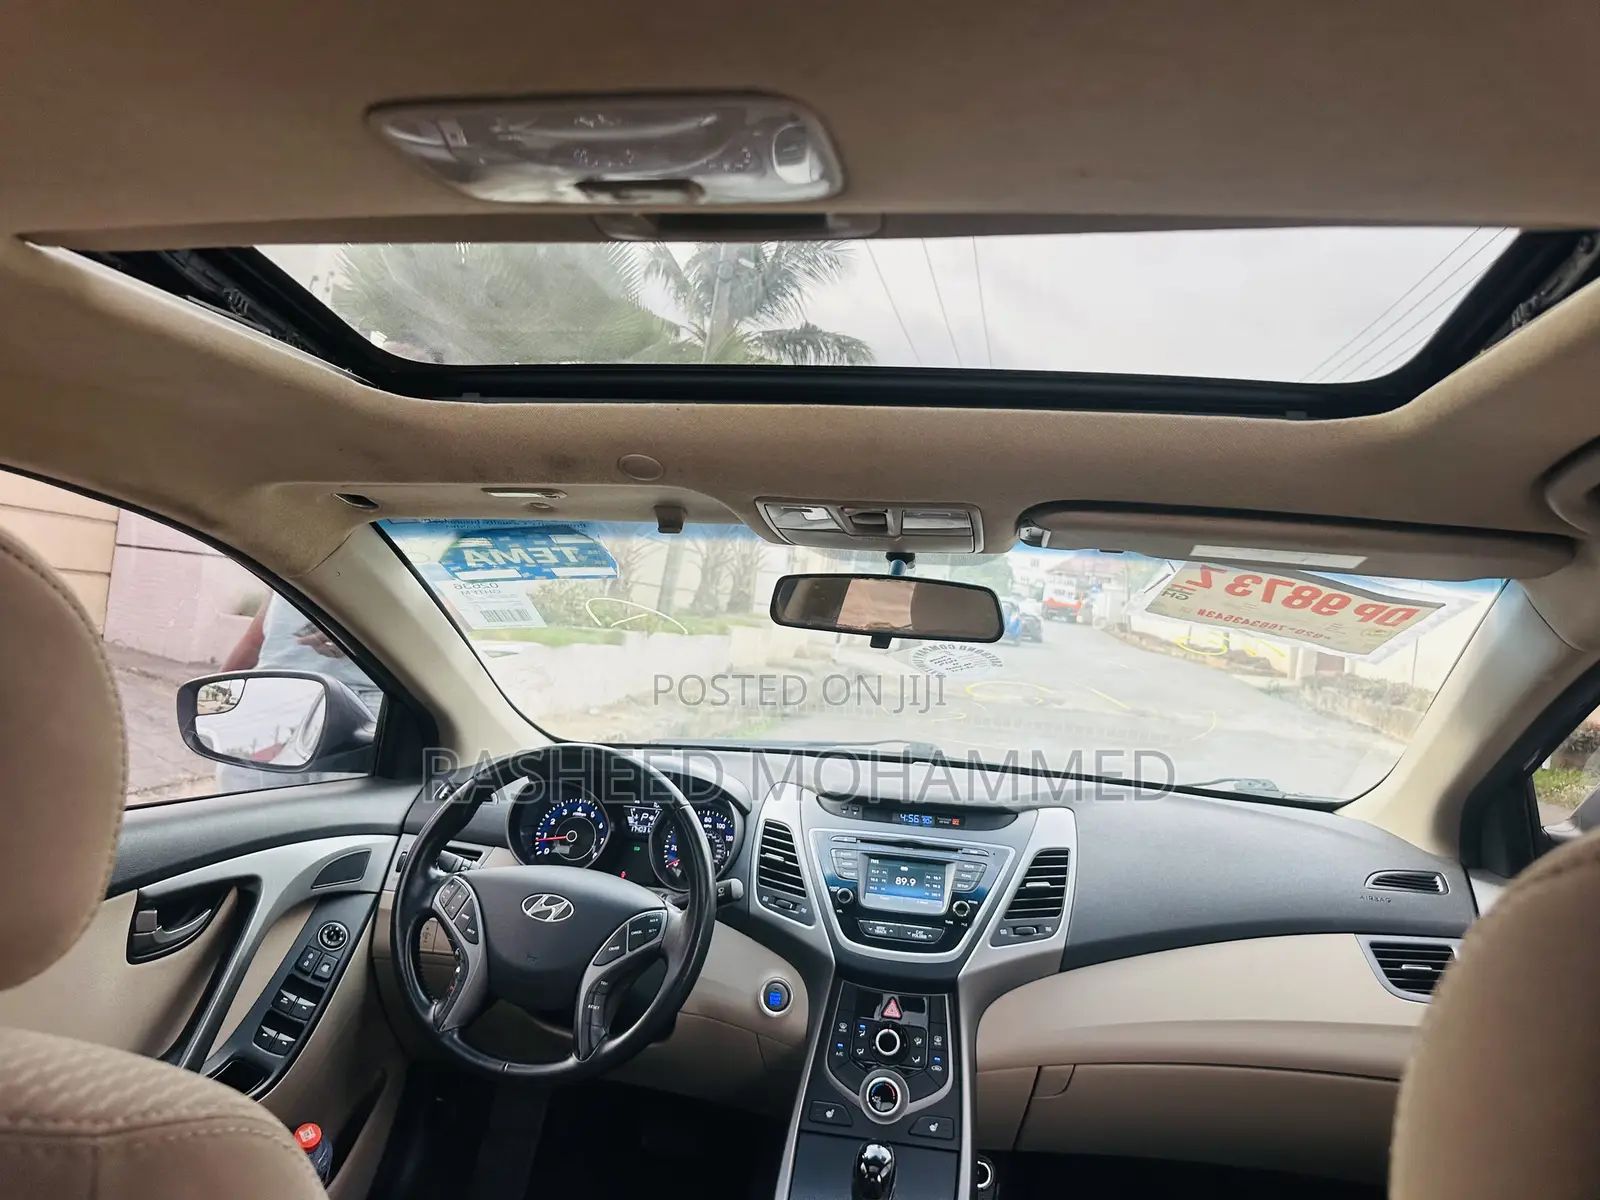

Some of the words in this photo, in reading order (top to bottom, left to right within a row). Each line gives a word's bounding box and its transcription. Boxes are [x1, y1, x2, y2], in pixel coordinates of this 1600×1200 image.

[562, 808, 568, 816] 3
[577, 805, 583, 813] 4
[590, 810, 596, 818] 5
[550, 818, 556, 826] 2
[900, 813, 920, 824] 4:56
[598, 822, 604, 830] 6
[725, 835, 734, 843] 120
[895, 876, 917, 887] 89.9
